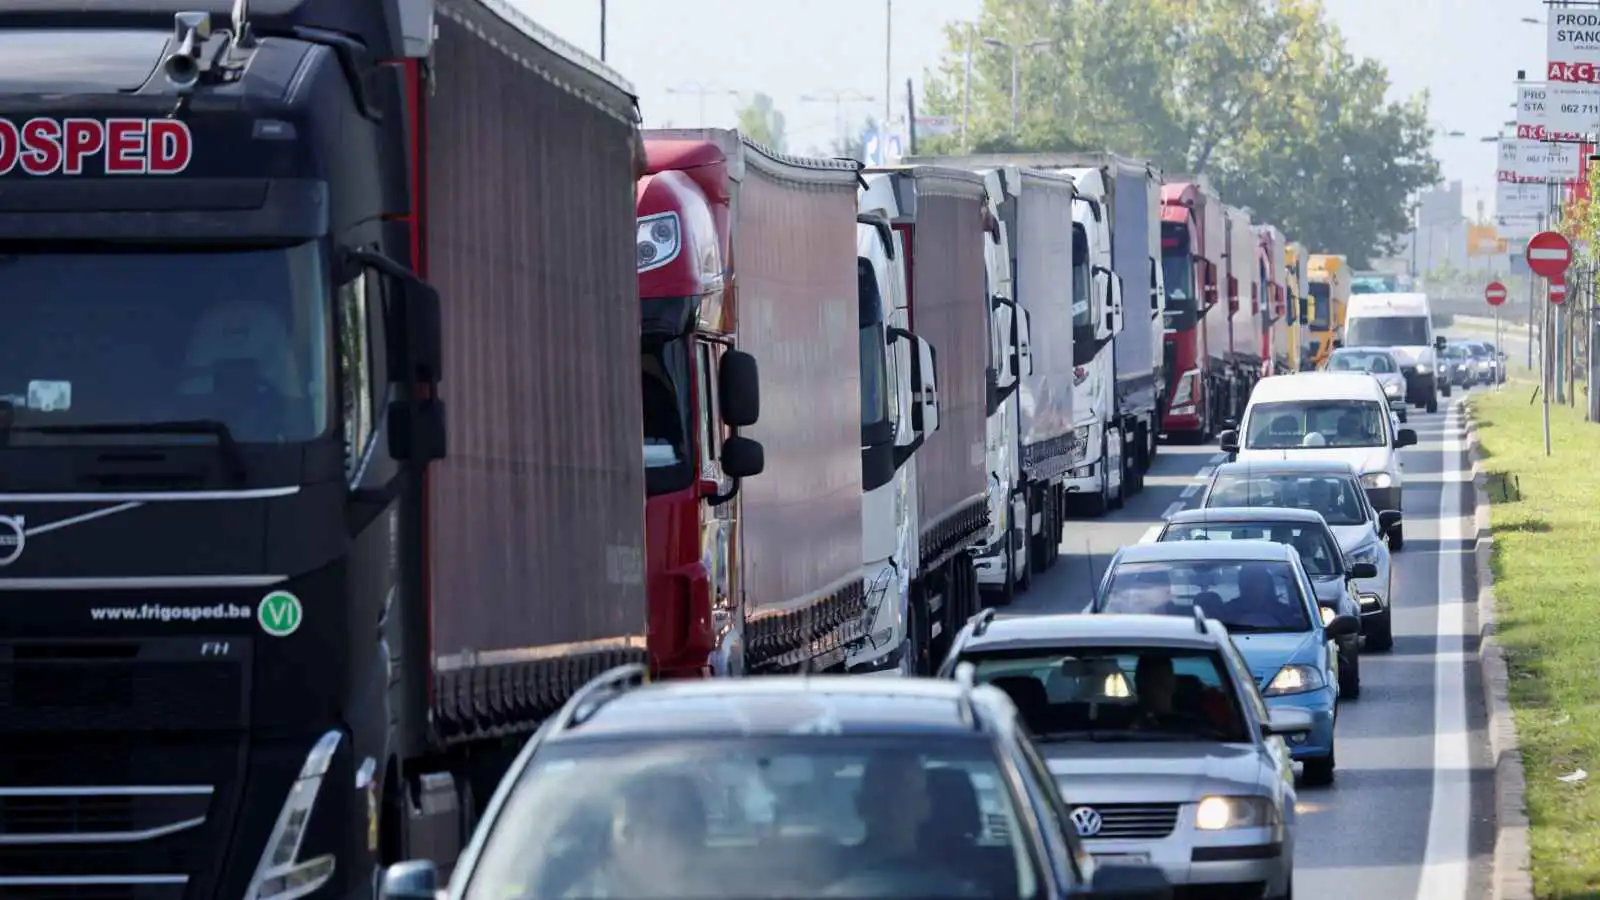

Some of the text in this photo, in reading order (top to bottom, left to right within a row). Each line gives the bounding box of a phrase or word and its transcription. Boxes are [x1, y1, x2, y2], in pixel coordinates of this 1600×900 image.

[1557, 14, 1600, 26] PROD
[91, 604, 251, 621] www.frigosped.ba
[267, 602, 294, 626] VI
[200, 641, 229, 656] FH
